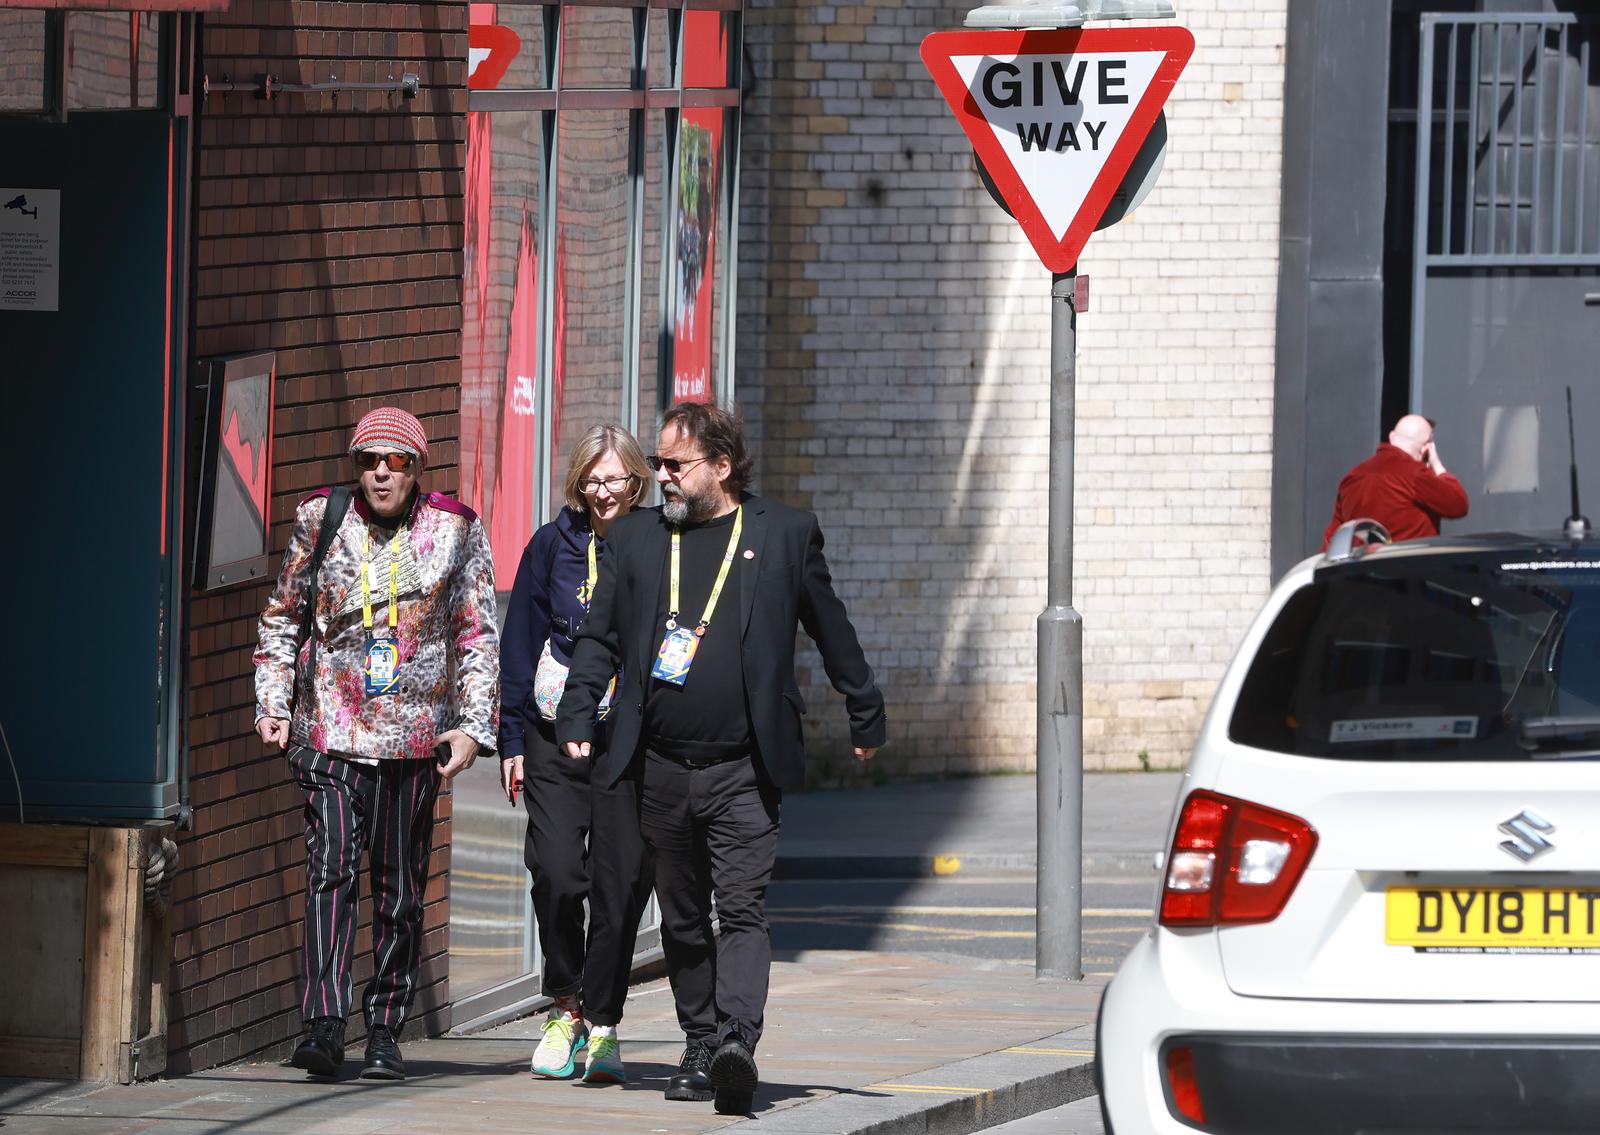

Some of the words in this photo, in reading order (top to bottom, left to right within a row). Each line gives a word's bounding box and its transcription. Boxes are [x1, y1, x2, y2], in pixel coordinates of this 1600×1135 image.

[982, 60, 1129, 109] GIVE
[1016, 121, 1107, 152] WAY
[1416, 890, 1524, 934] DY18
[1543, 891, 1600, 934] HT
